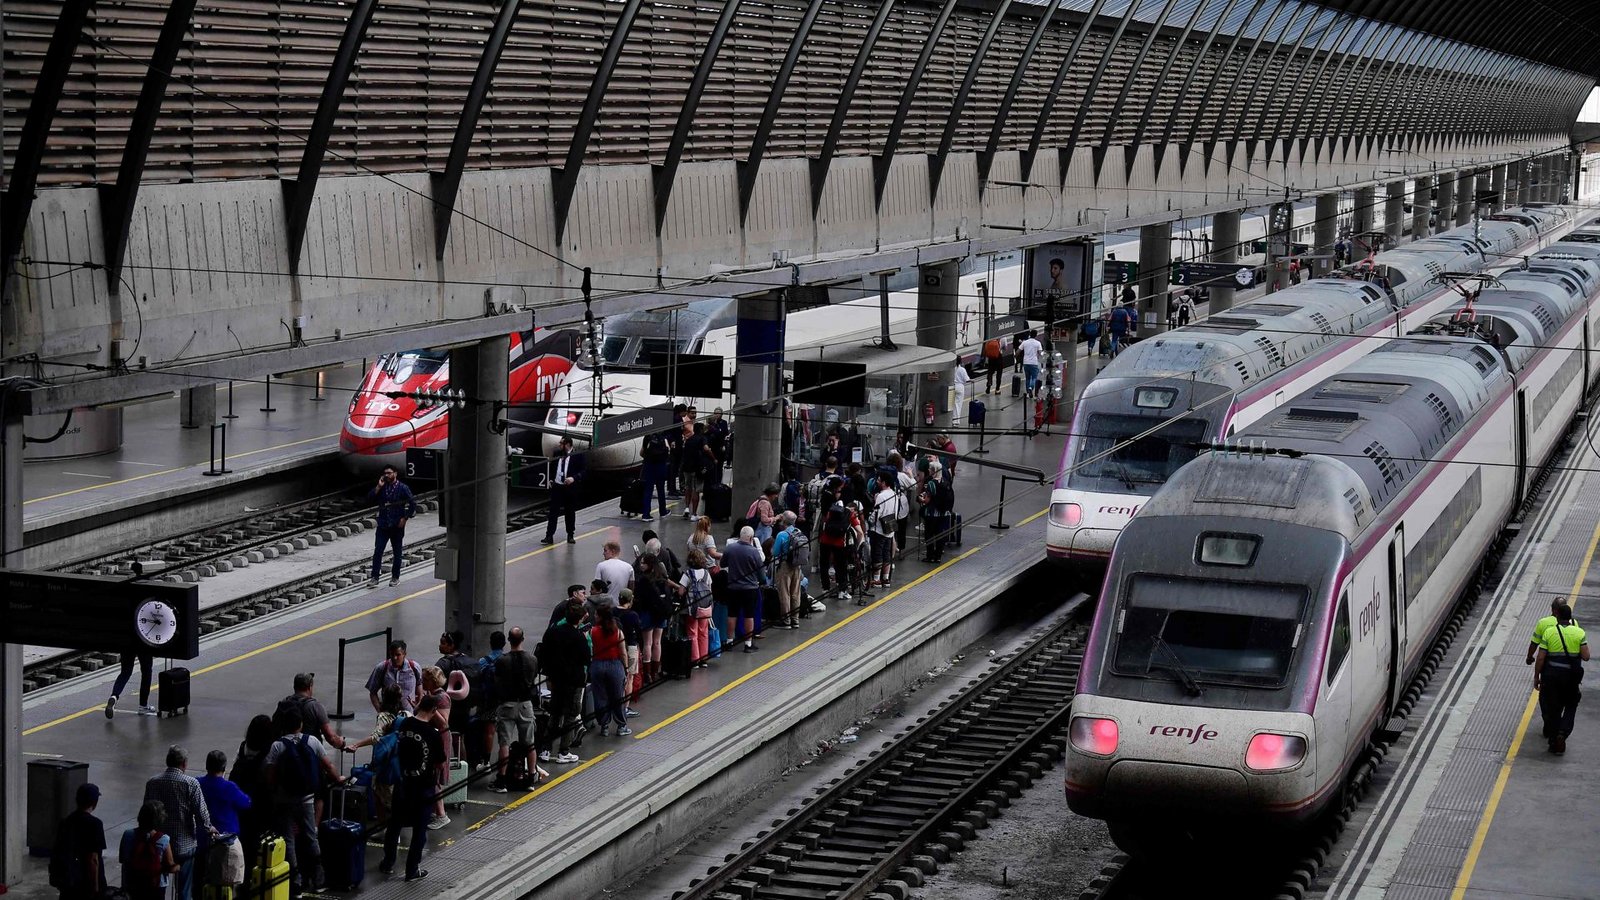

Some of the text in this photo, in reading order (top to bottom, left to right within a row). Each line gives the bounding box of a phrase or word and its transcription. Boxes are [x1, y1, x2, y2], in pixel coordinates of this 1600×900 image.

[1122, 273, 1128, 283] 3
[1178, 273, 1185, 284] 2
[365, 399, 400, 412] iryo
[617, 415, 654, 434] Sevilla Santa Justa
[408, 462, 415, 476] 3
[538, 472, 546, 487] 2
[1098, 503, 1141, 519] renf
[1359, 575, 1381, 646] renfe
[1149, 723, 1218, 745] renfe
